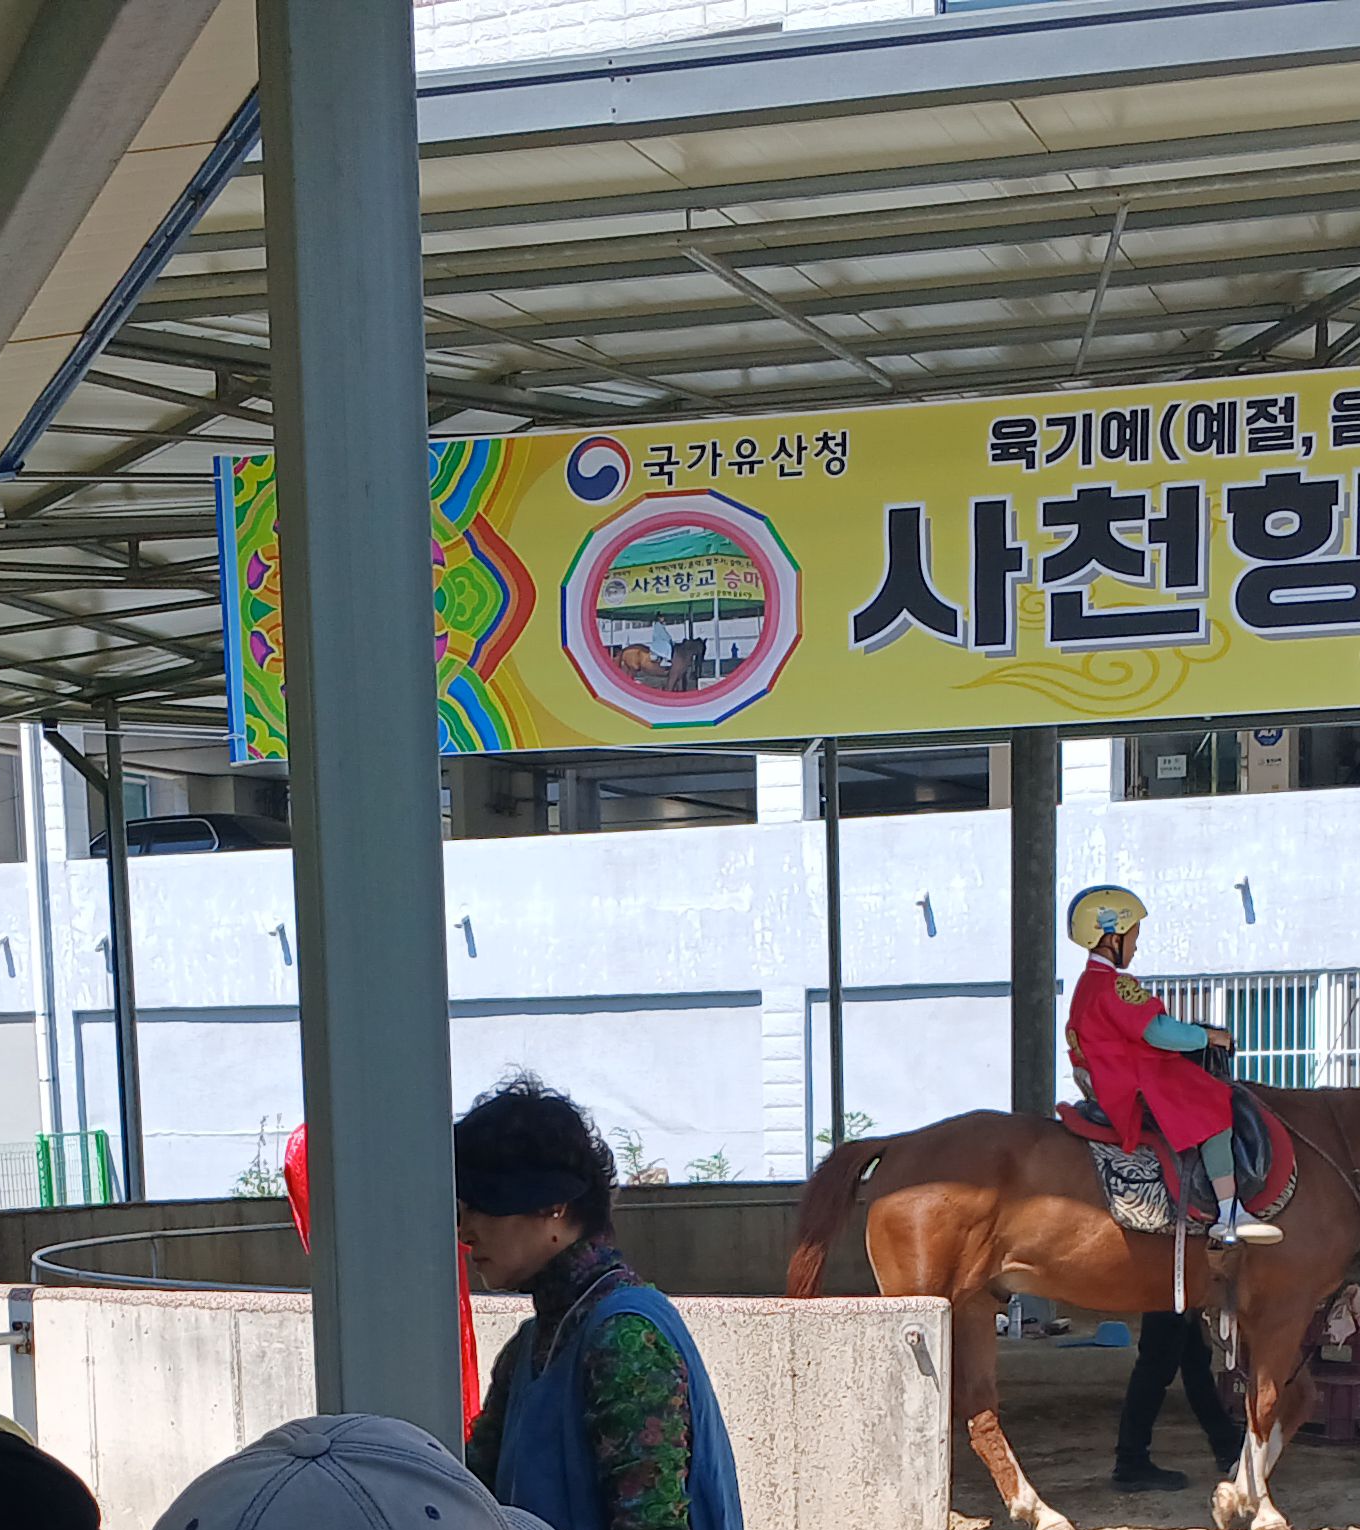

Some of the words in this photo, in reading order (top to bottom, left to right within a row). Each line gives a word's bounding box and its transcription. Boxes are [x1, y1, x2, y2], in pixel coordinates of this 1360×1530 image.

[643, 430, 849, 487] 국가유산청
[990, 396, 1314, 467] 육기예(예절,
[631, 569, 717, 593] 사천향교
[723, 569, 761, 590] 승마
